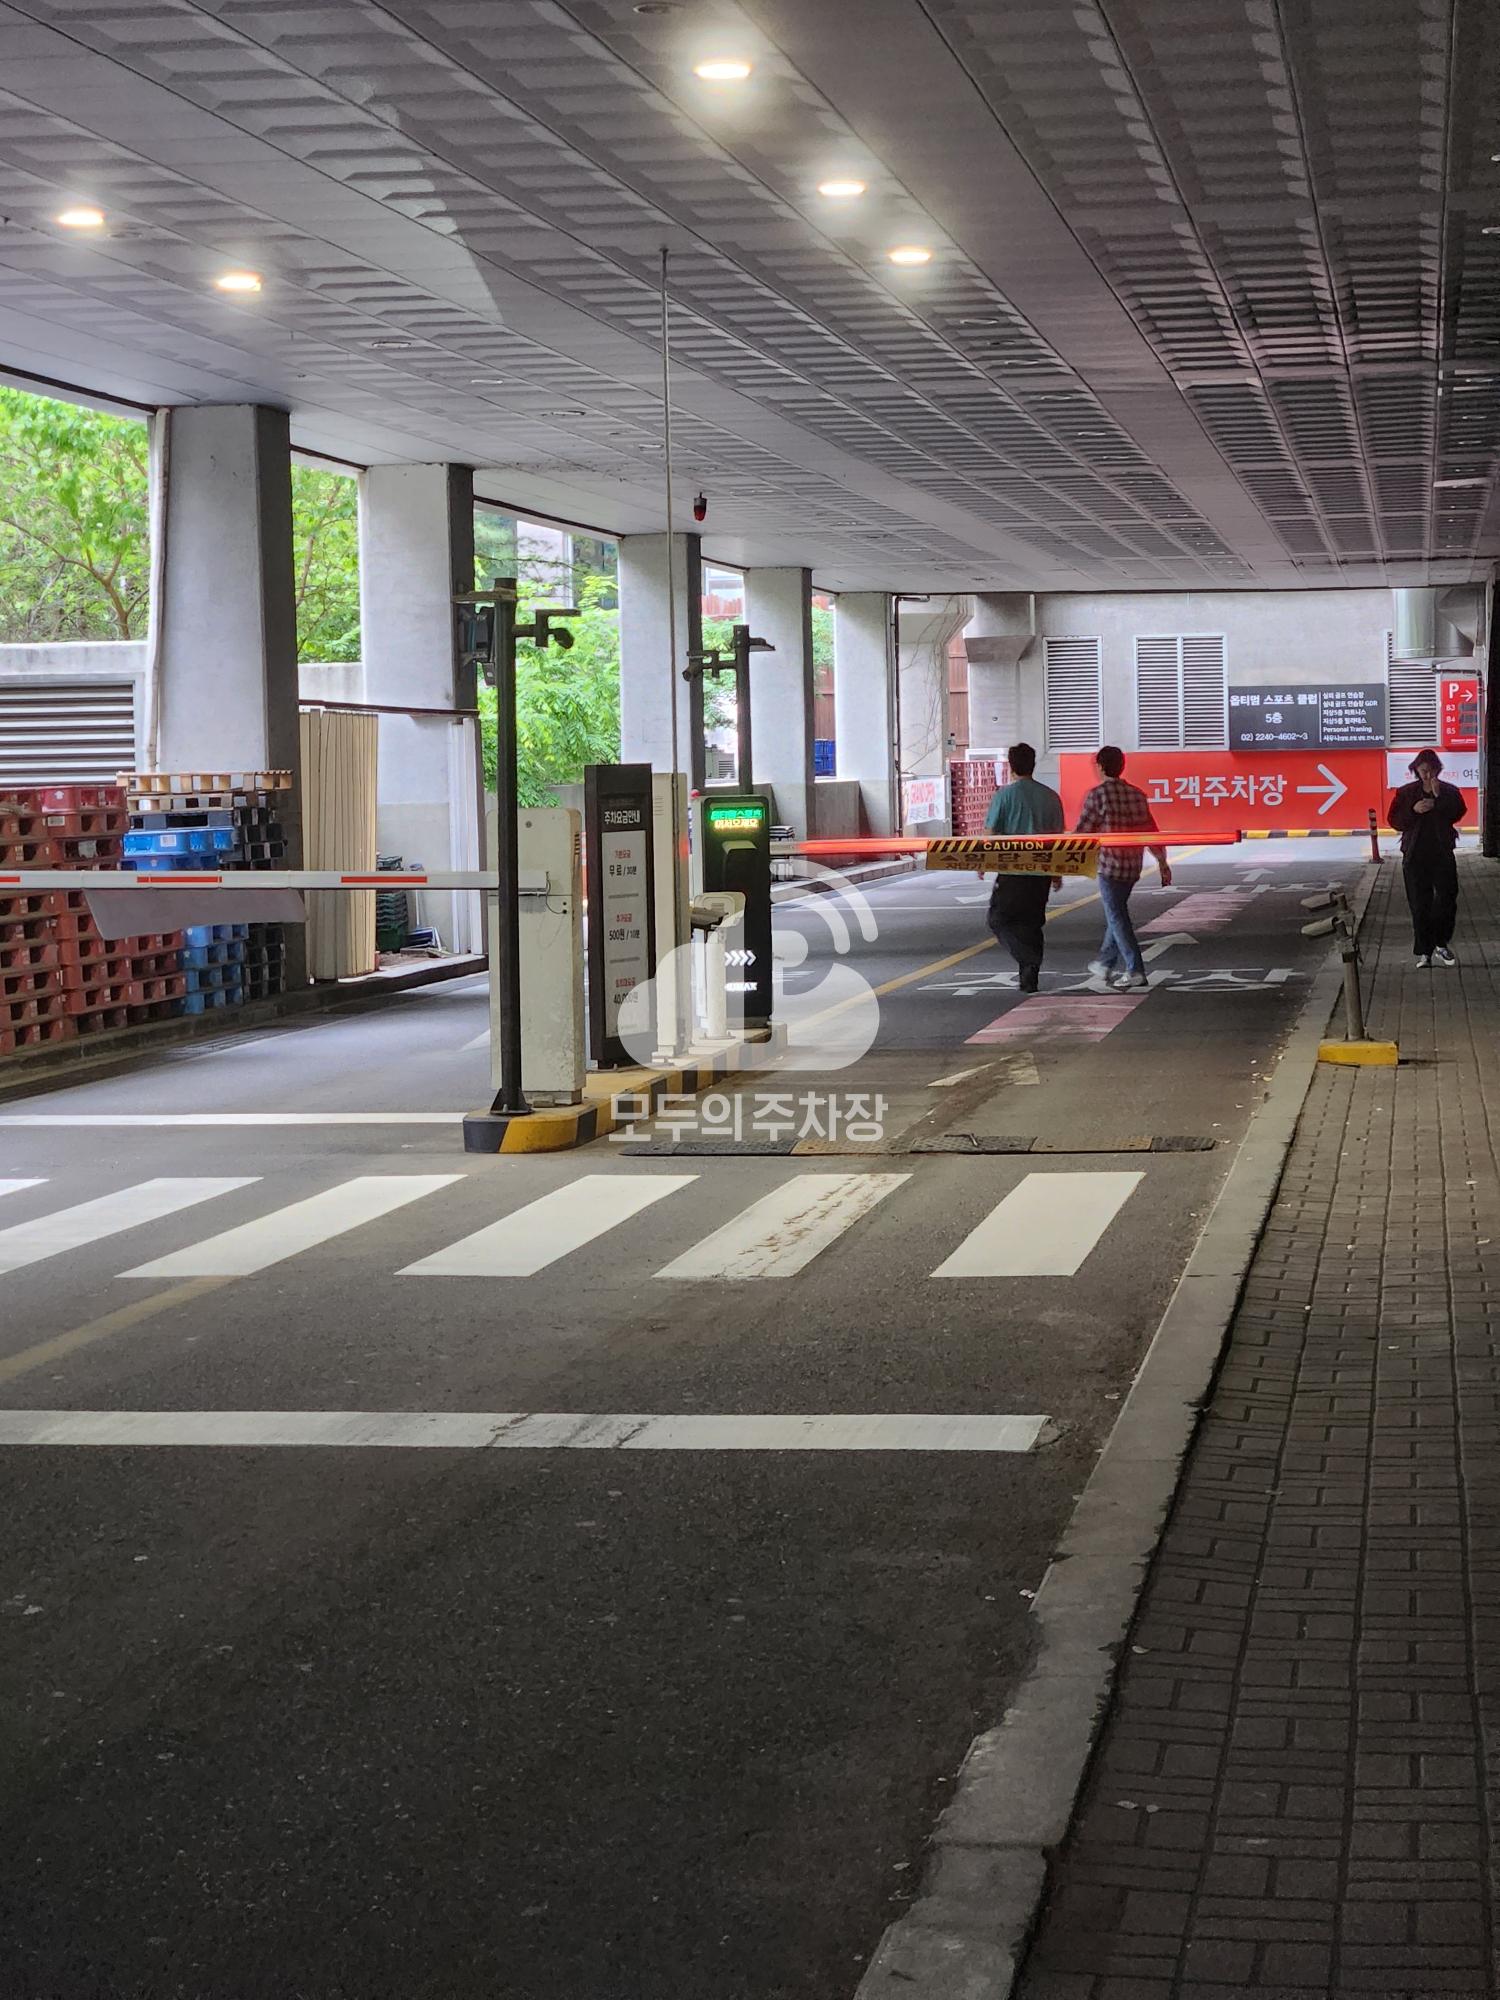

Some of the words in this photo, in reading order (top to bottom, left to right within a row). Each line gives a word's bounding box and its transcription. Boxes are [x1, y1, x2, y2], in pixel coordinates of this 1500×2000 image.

[1449, 683, 1459, 699] P
[1263, 694, 1294, 705] 스포츠
[1297, 693, 1318, 705] 클럽
[1265, 711, 1283, 723] 5층
[1446, 727, 1456, 735] B5
[1147, 774, 1288, 807] 고객주차장
[604, 810, 640, 824] 주차요금안내
[983, 841, 1044, 850] CAUTION
